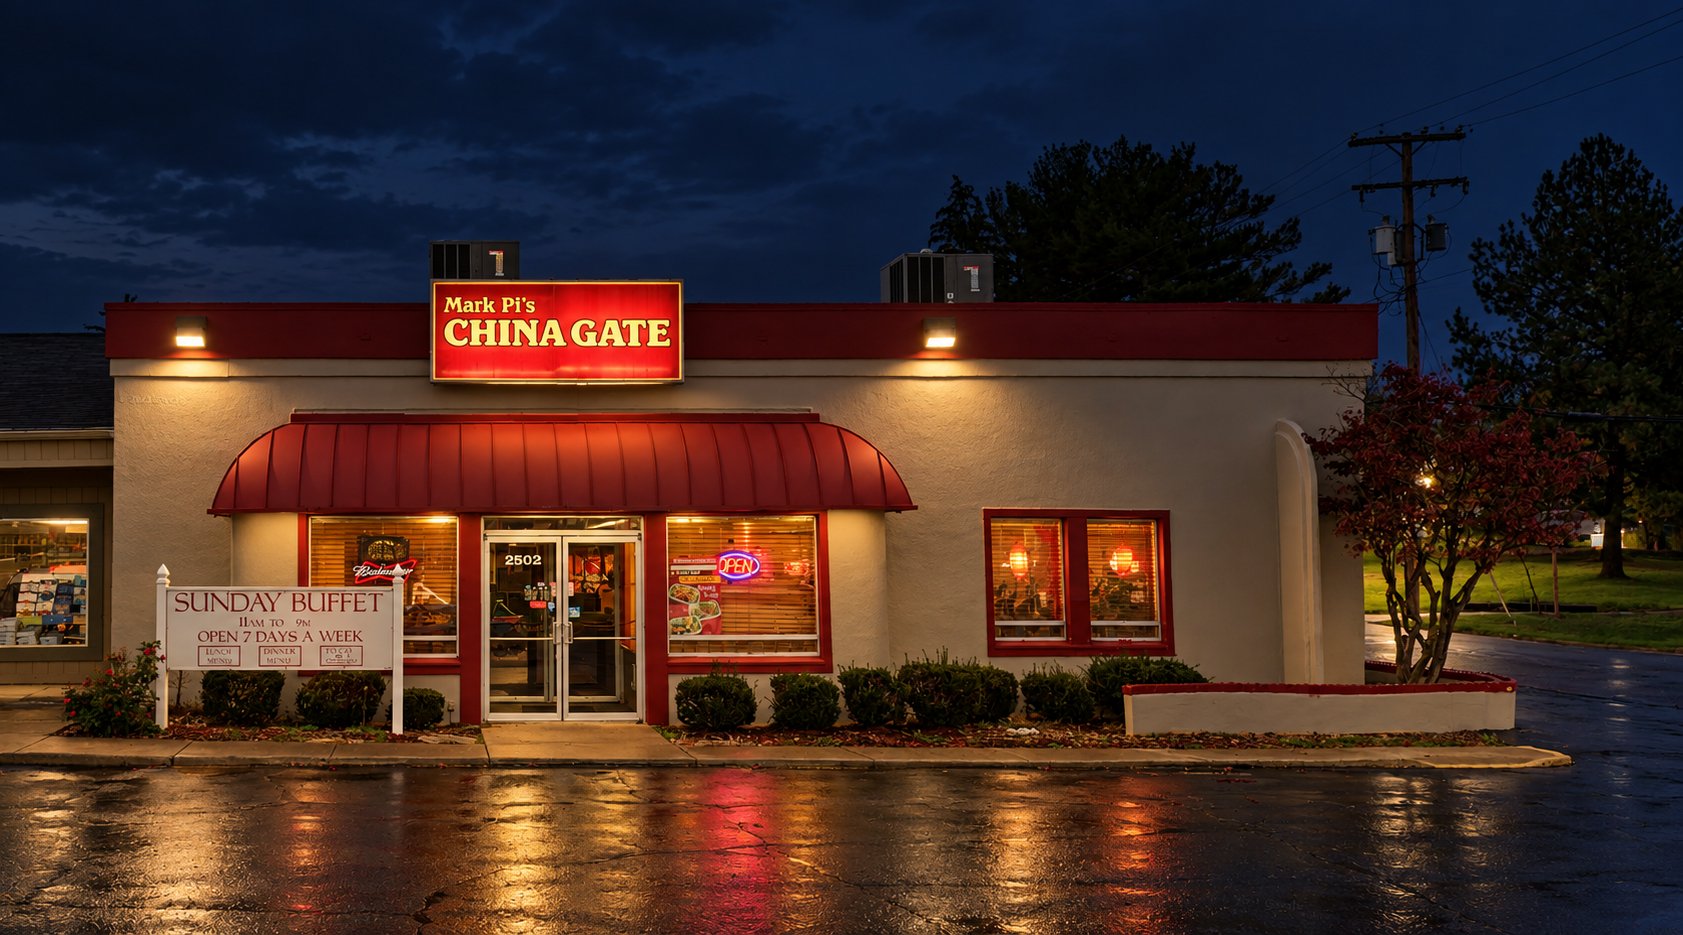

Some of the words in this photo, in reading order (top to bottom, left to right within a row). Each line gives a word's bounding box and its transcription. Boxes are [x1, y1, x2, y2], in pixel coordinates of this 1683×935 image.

[443, 296, 496, 313] Mark
[501, 296, 536, 313] Pi's
[443, 318, 567, 347] CHINA
[570, 318, 671, 347] GATE
[504, 554, 542, 566] 2502
[719, 557, 754, 574] OPEN
[174, 592, 281, 613] SUNDAY
[291, 592, 384, 613] BUFFET
[269, 618, 285, 627] TO
[197, 630, 238, 643] OPEN
[243, 630, 252, 643] 7
[255, 630, 298, 643] DAYS
[302, 630, 314, 643] A
[319, 630, 363, 643] WEEK
